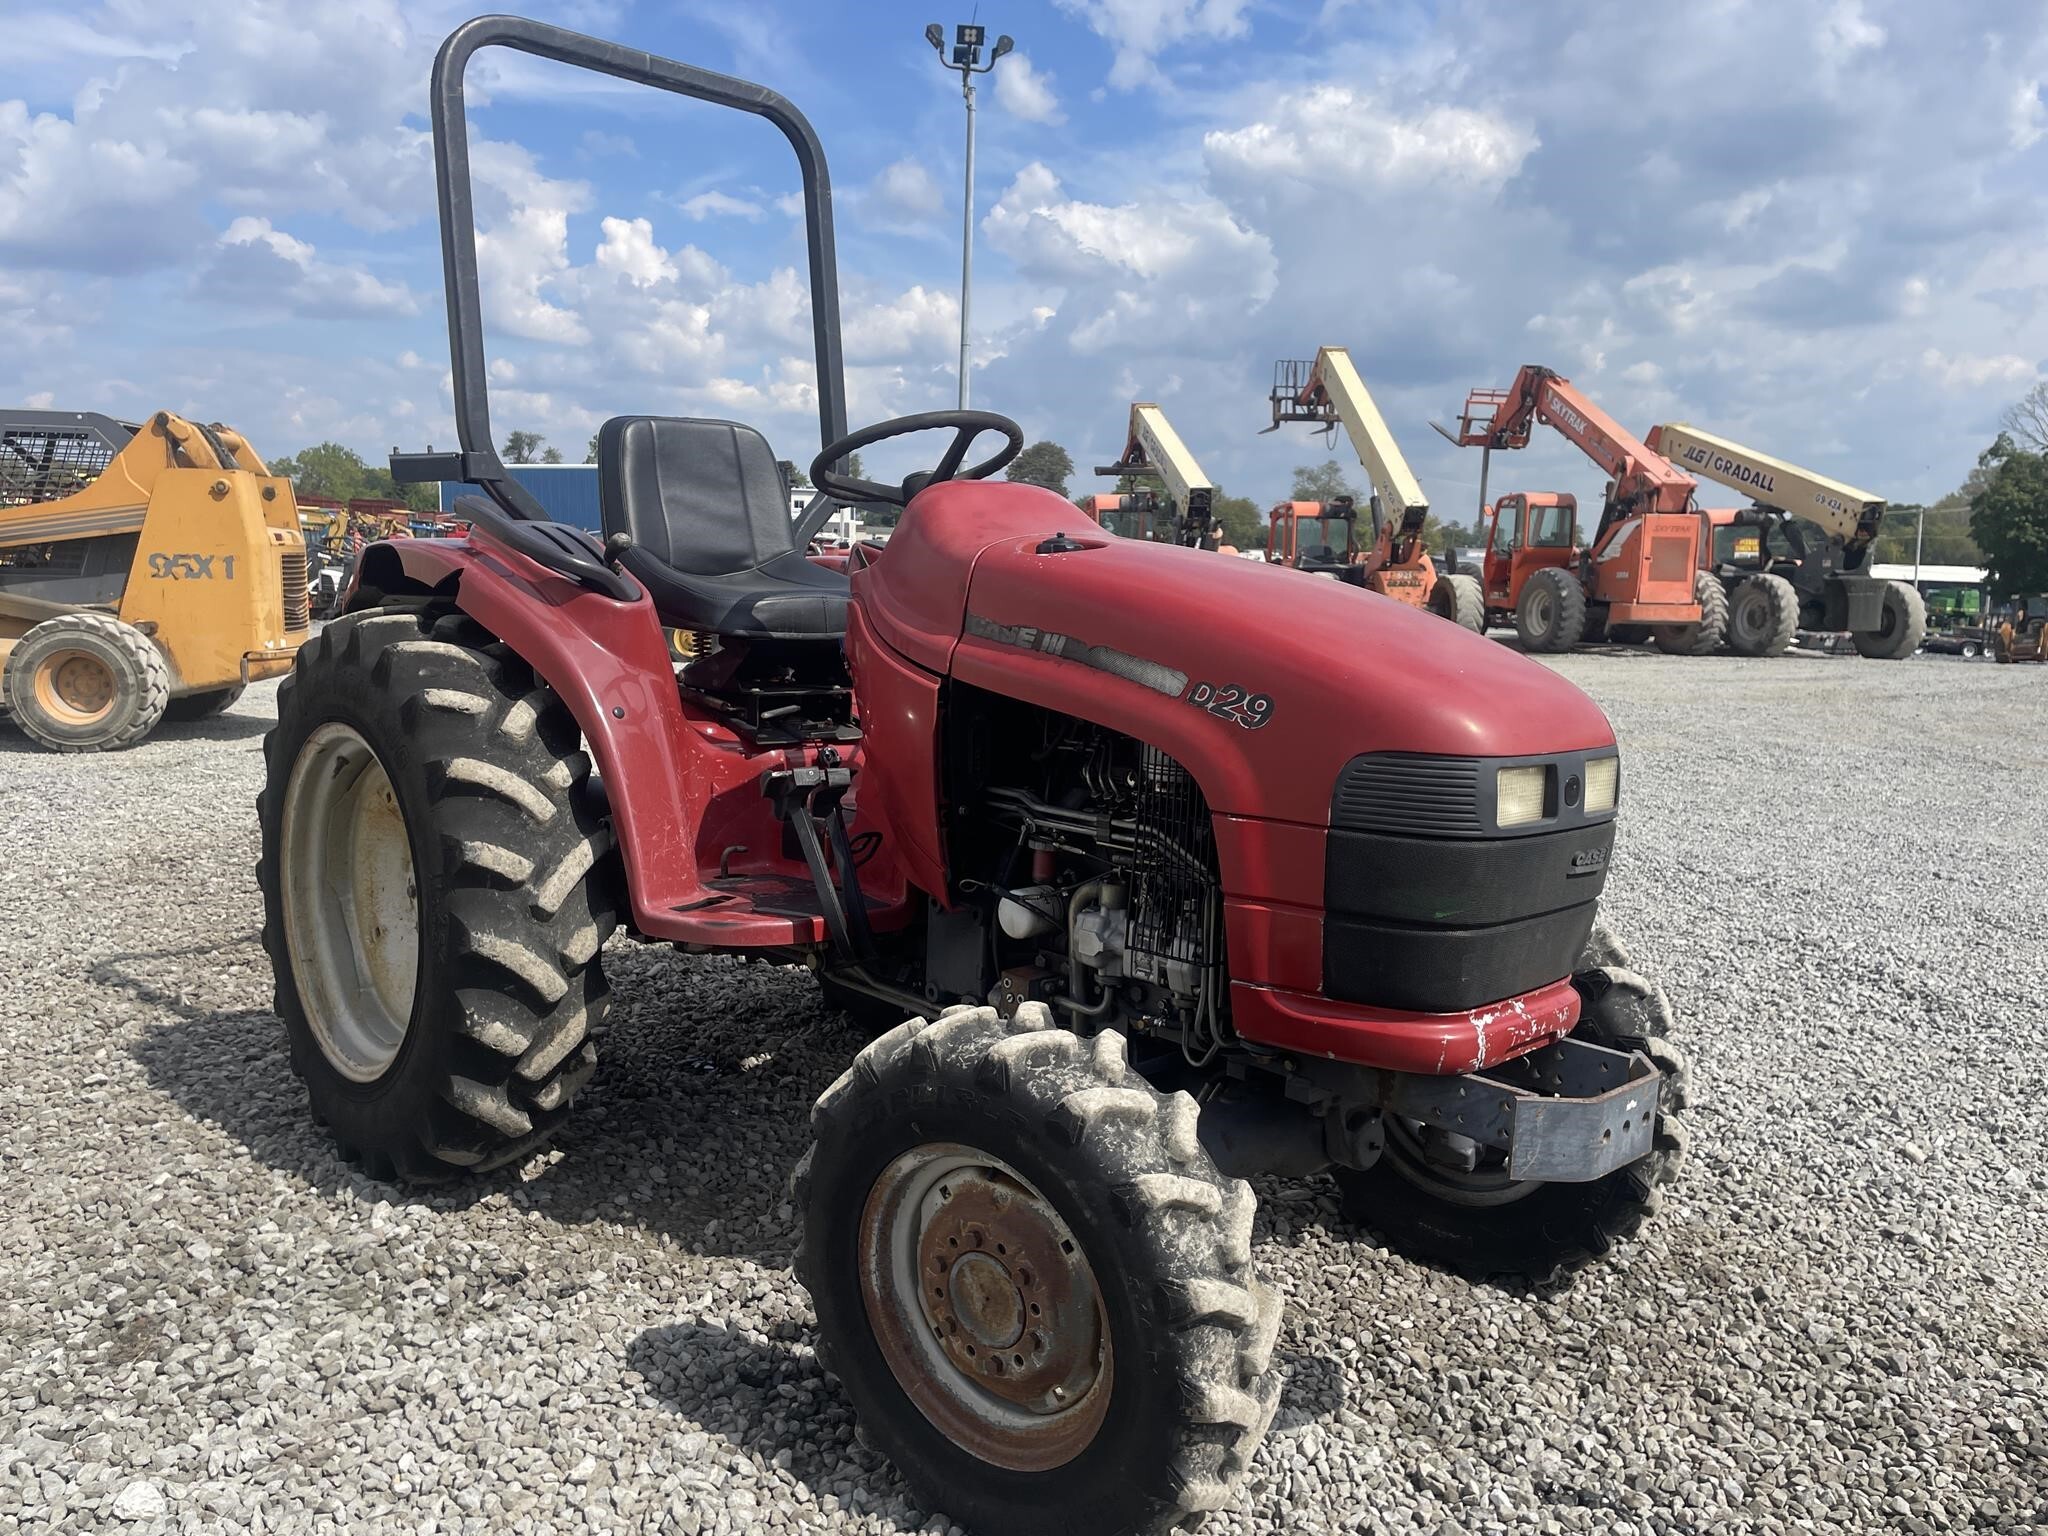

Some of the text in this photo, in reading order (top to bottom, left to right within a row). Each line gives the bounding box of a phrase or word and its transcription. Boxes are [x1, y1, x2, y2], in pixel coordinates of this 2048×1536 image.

[1551, 397, 1587, 435] SKYTRAK
[1683, 445, 1775, 493] JLG GRADALL
[1186, 681, 1275, 730] D29
